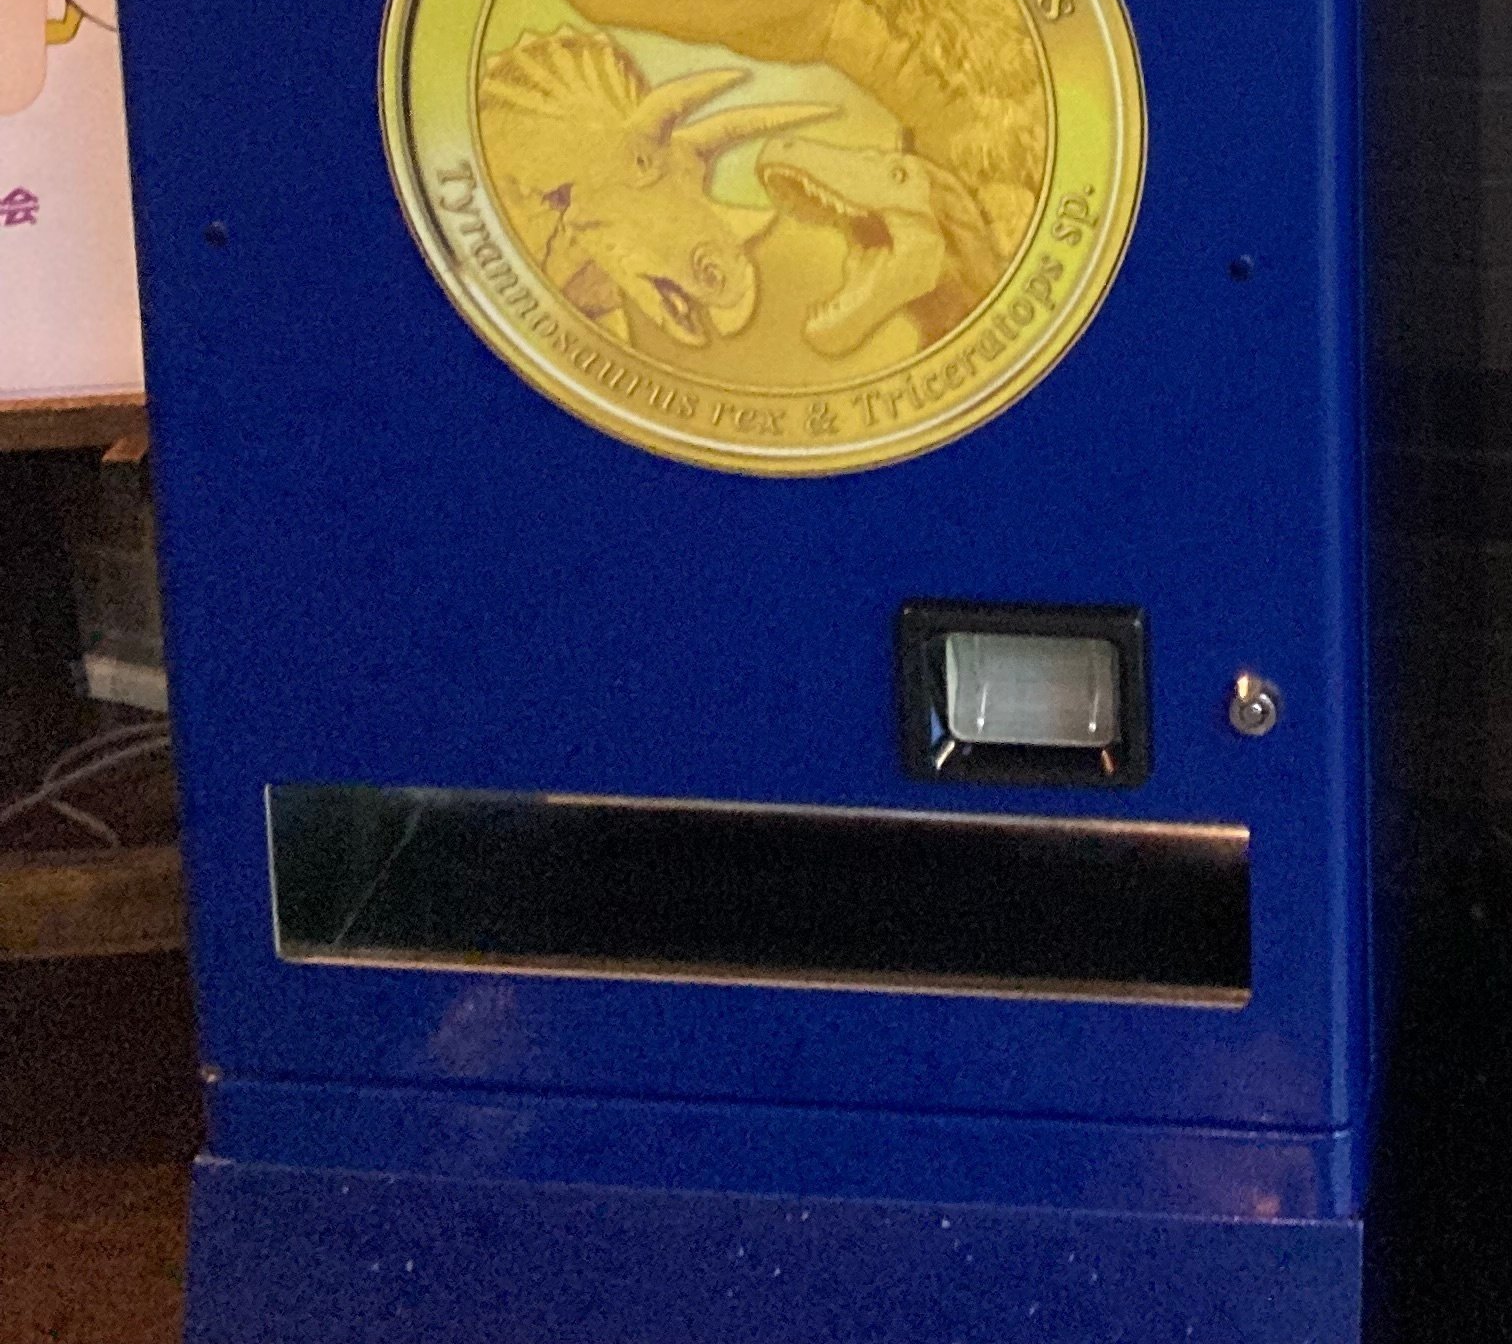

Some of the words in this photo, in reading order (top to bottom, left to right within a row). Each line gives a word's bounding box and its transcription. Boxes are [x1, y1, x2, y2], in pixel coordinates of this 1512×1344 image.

[436, 160, 697, 421] Tyrannosaurus
[711, 401, 787, 437] rex
[851, 249, 1065, 430] Triceratops
